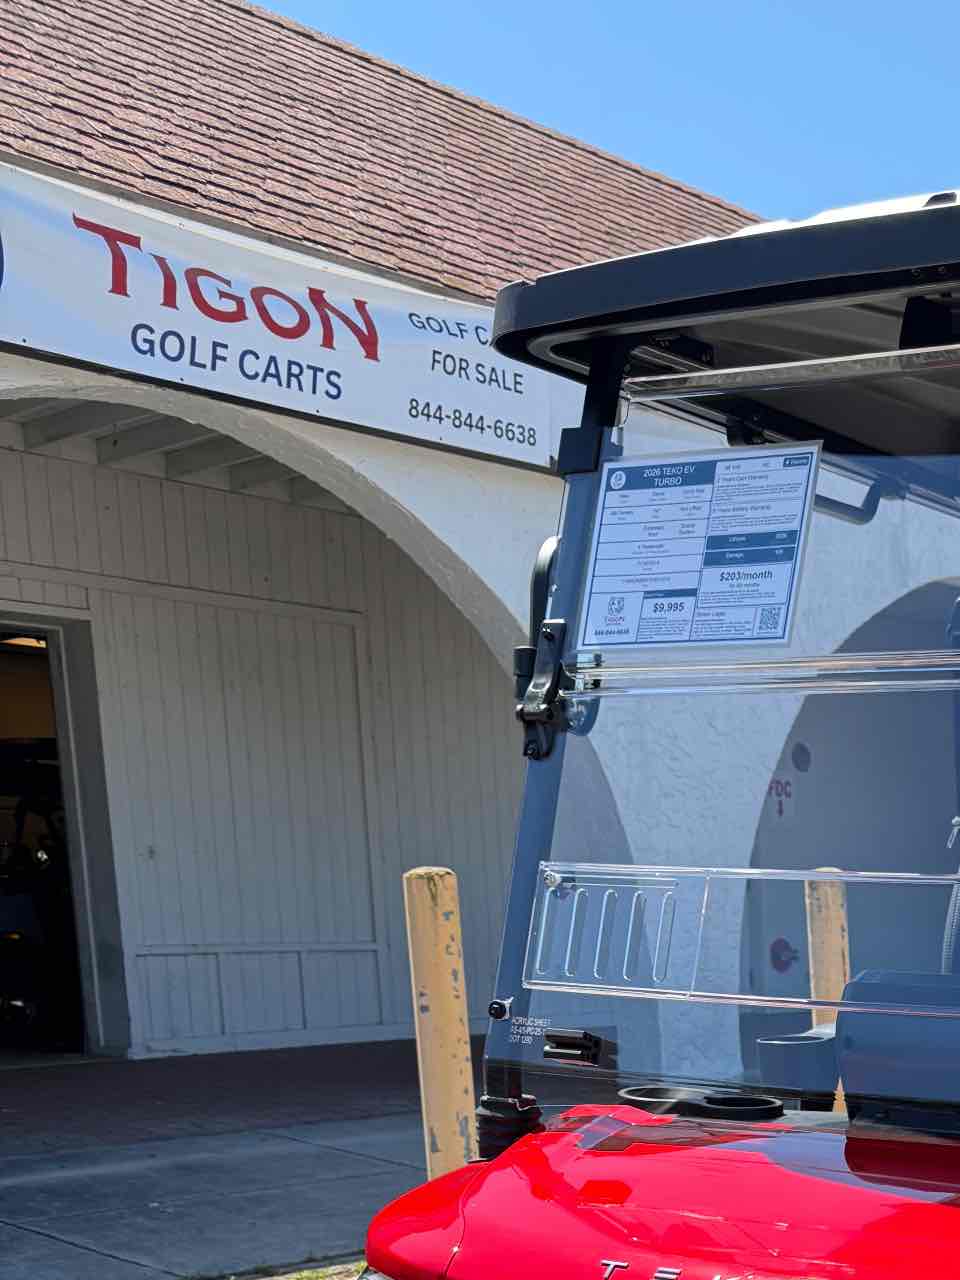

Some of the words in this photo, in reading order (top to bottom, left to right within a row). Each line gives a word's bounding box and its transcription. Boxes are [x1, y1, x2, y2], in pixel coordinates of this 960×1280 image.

[72, 212, 380, 362] TIGON
[408, 312, 469, 340] GOLF
[130, 322, 230, 372] GOLF
[238, 348, 343, 400] CARTS
[431, 349, 470, 382] FOR
[475, 362, 525, 395] SALE
[408, 397, 538, 447] 844-844-6638
[654, 476, 683, 488] TURBO
[684, 464, 696, 474] EV
[720, 569, 773, 582] $203/month
[768, 779, 792, 799] FDC
